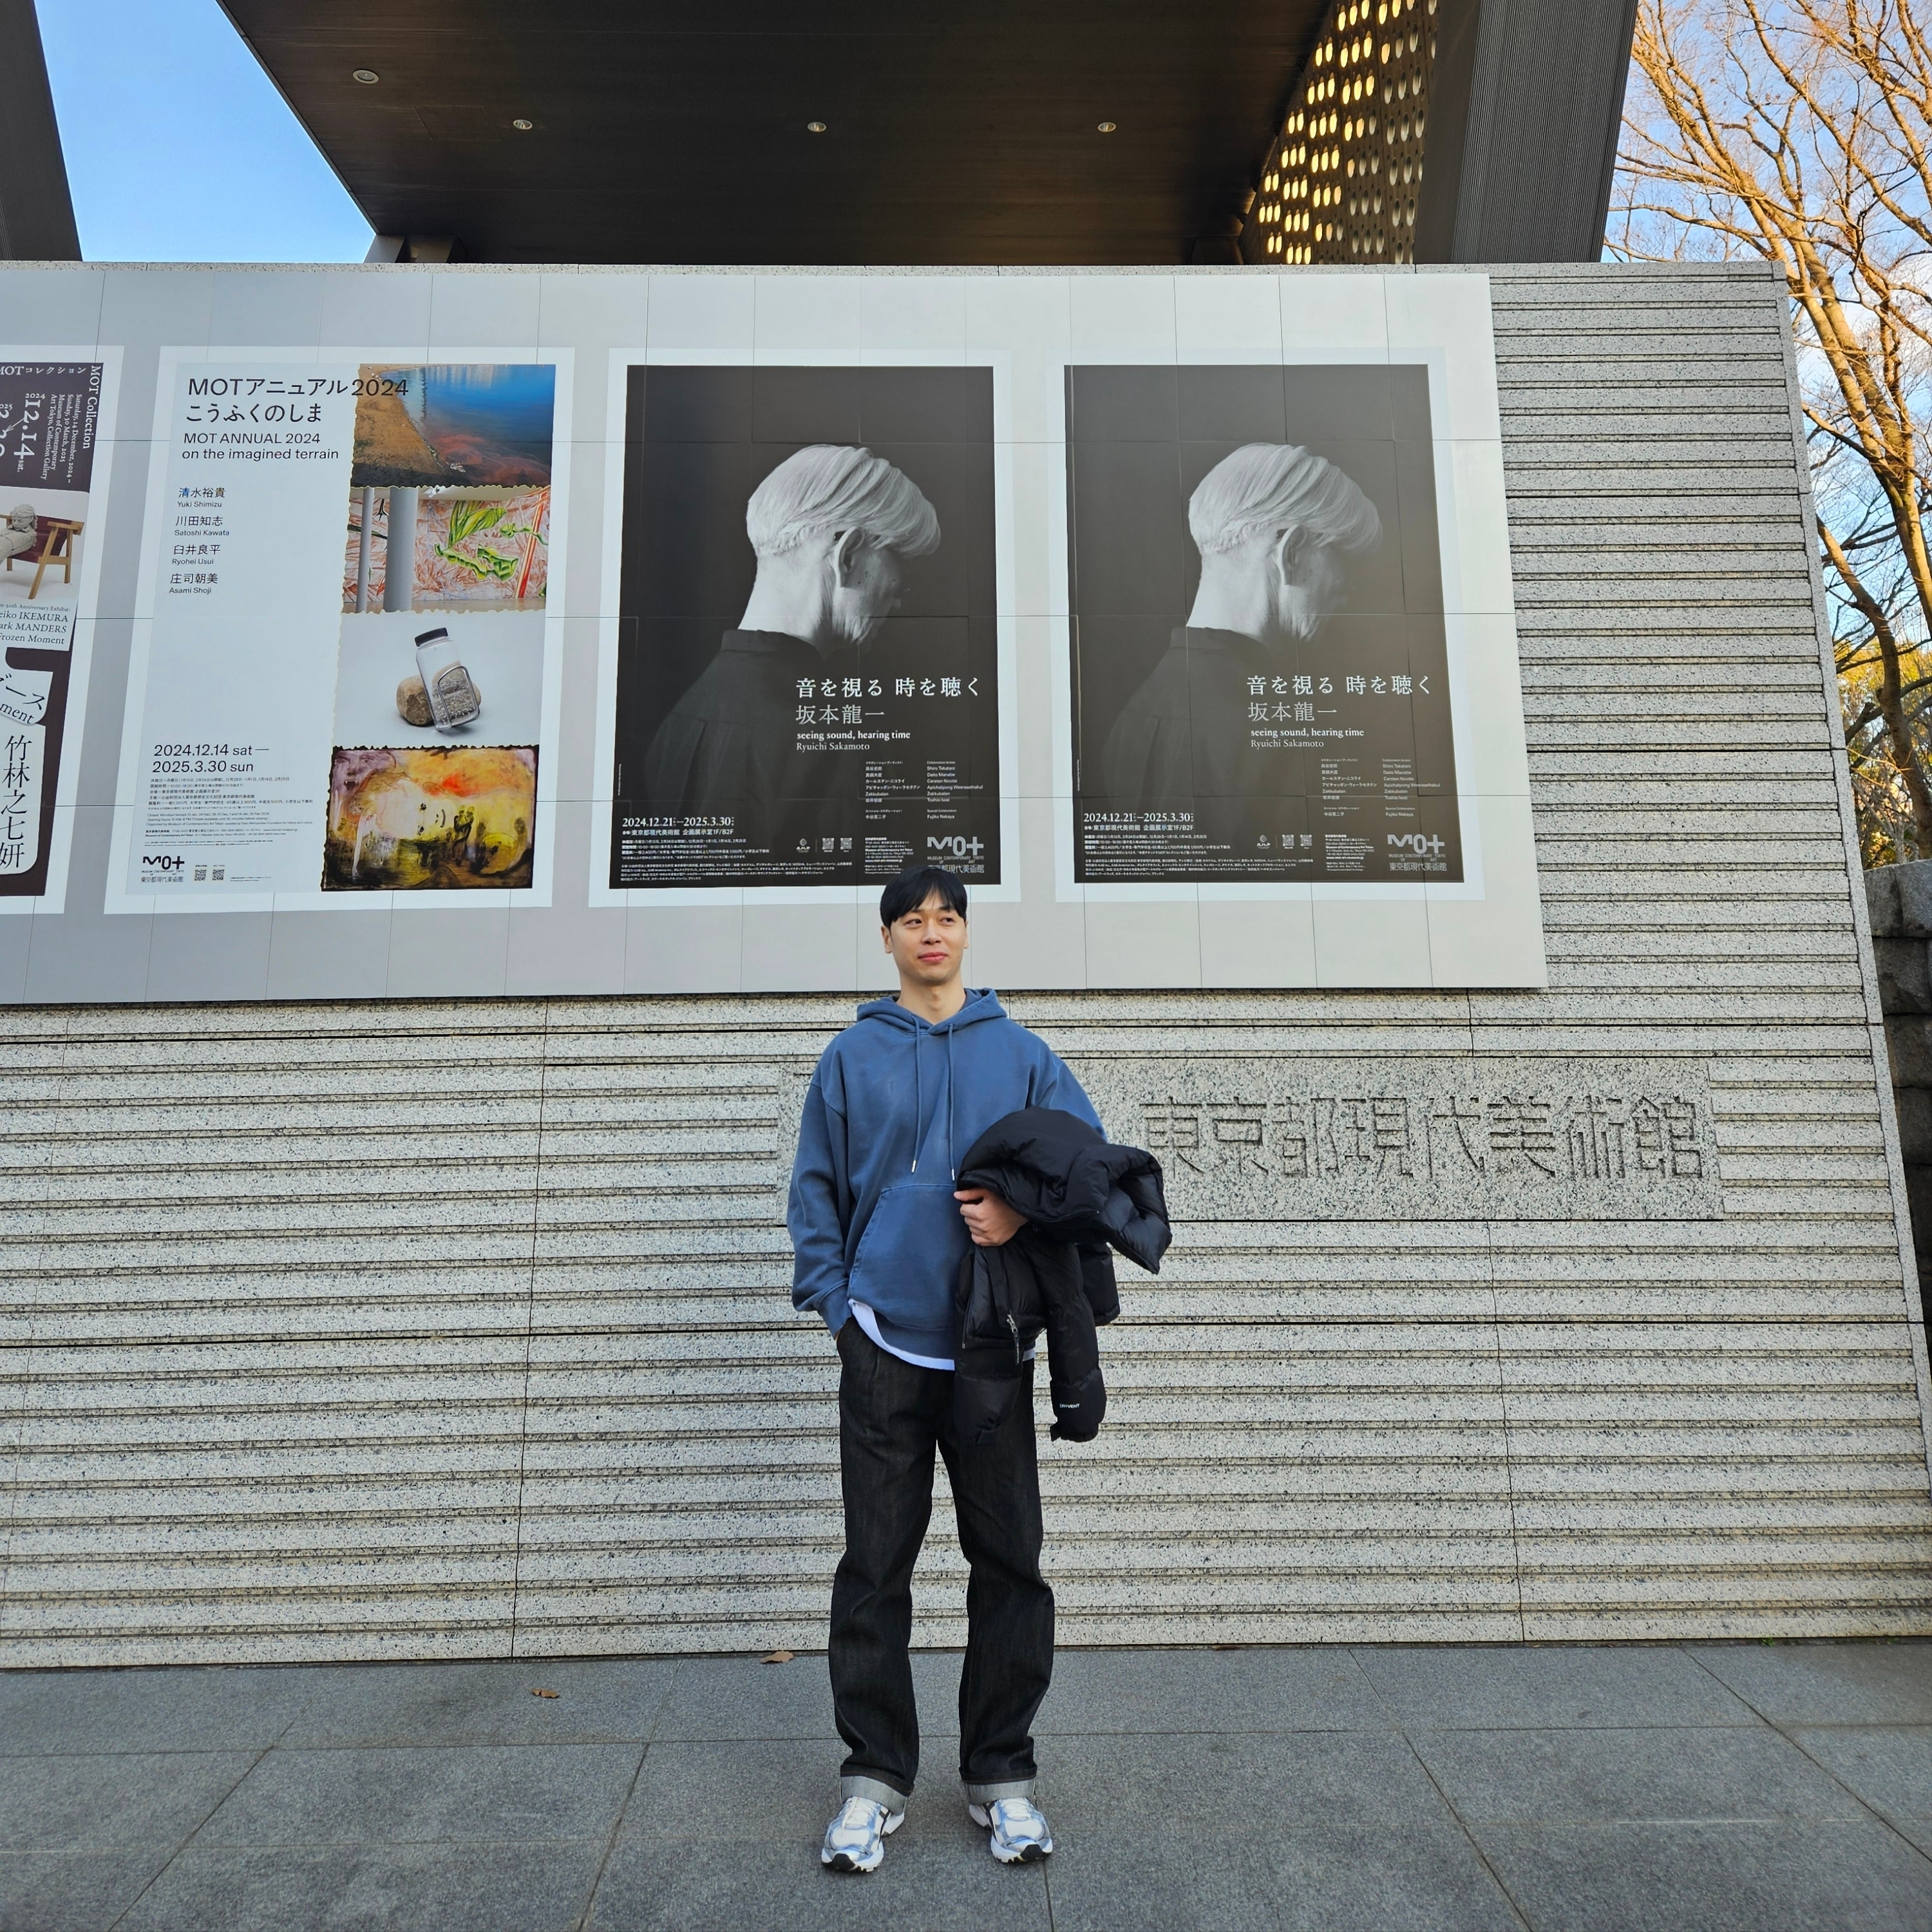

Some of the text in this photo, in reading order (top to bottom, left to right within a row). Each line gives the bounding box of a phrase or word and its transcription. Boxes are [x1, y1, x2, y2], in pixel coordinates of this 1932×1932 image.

[56, 394, 65, 419] Museum
[82, 365, 101, 449] MOT Collection
[186, 402, 321, 422] こうふくのしま
[184, 433, 321, 444] MOT ANNUAL 2024
[203, 449, 224, 459] the
[229, 449, 290, 462] imagined
[295, 449, 339, 459] terrain
[178, 487, 225, 498] 清水裕貴
[176, 516, 223, 526] 川田知志
[173, 545, 221, 555] 臼井良平
[170, 573, 218, 584] 庄司朝美
[19, 612, 68, 622] IKEMURA
[15, 623, 67, 633] MANDERS
[28, 635, 64, 644] Moment
[796, 677, 978, 697] 音を視る 時を聴く
[1247, 674, 1430, 696] 音を視る 時を聴く
[795, 705, 885, 724] 坂本龍一
[1248, 701, 1337, 722] 坂本龍一
[797, 730, 911, 741] seeing sound, hearing time
[1251, 728, 1364, 738] seeing sound, hearing time
[796, 742, 869, 753] Ryuichi Sakamoto
[1251, 739, 1324, 750] Ryuichi Sakamoto
[153, 744, 252, 757] 2024.12.14 sat
[152, 760, 254, 773] 2025.3.30 sun
[1137, 1095, 1705, 1180] 東京都現代美術館
